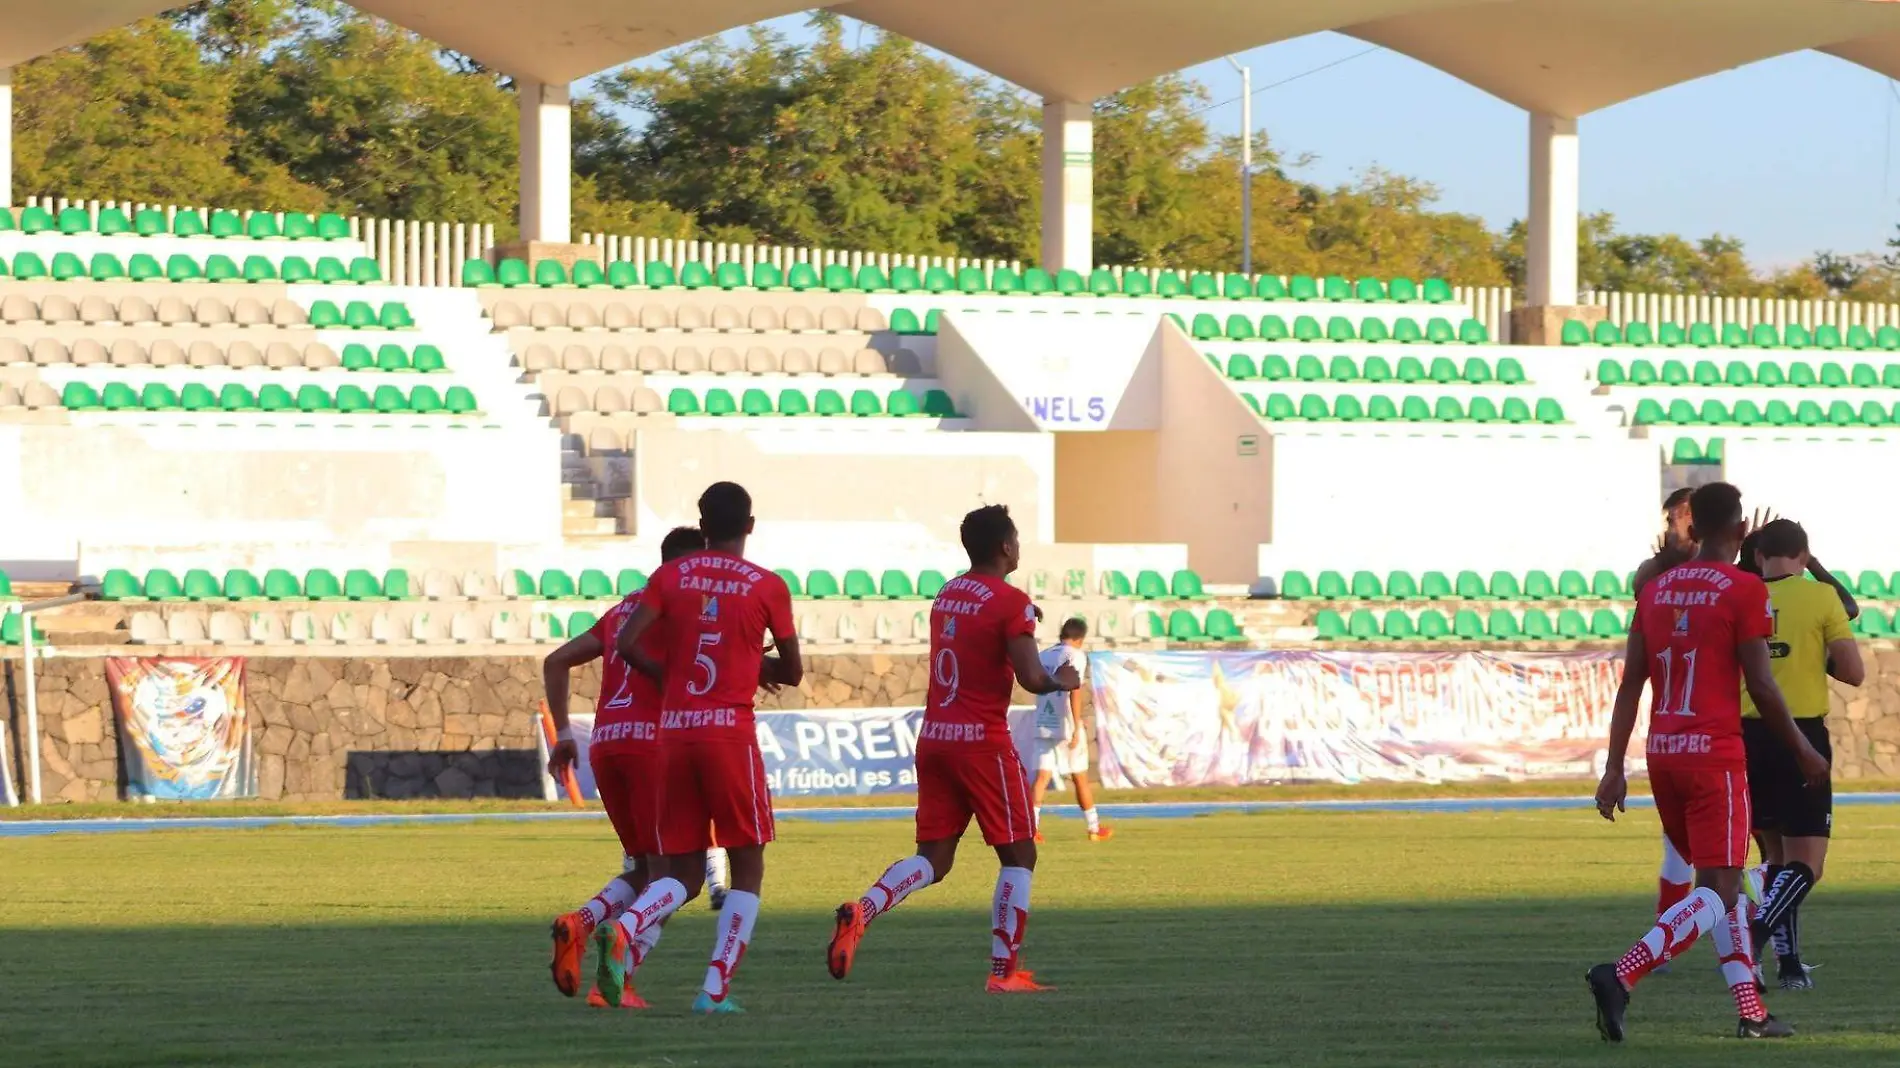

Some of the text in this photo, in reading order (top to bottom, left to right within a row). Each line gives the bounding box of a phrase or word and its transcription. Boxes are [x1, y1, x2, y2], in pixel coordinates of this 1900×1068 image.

[1025, 396, 1081, 422] NEL
[678, 556, 763, 583] SPORTING
[1657, 567, 1733, 590] SPORTING
[680, 575, 752, 597] CANAMY
[1653, 589, 1720, 607] CANAMY
[687, 632, 722, 696] 5
[934, 647, 959, 708] 9
[1655, 646, 1697, 717] 11
[787, 766, 857, 789] fútbol
[862, 769, 892, 787] es
